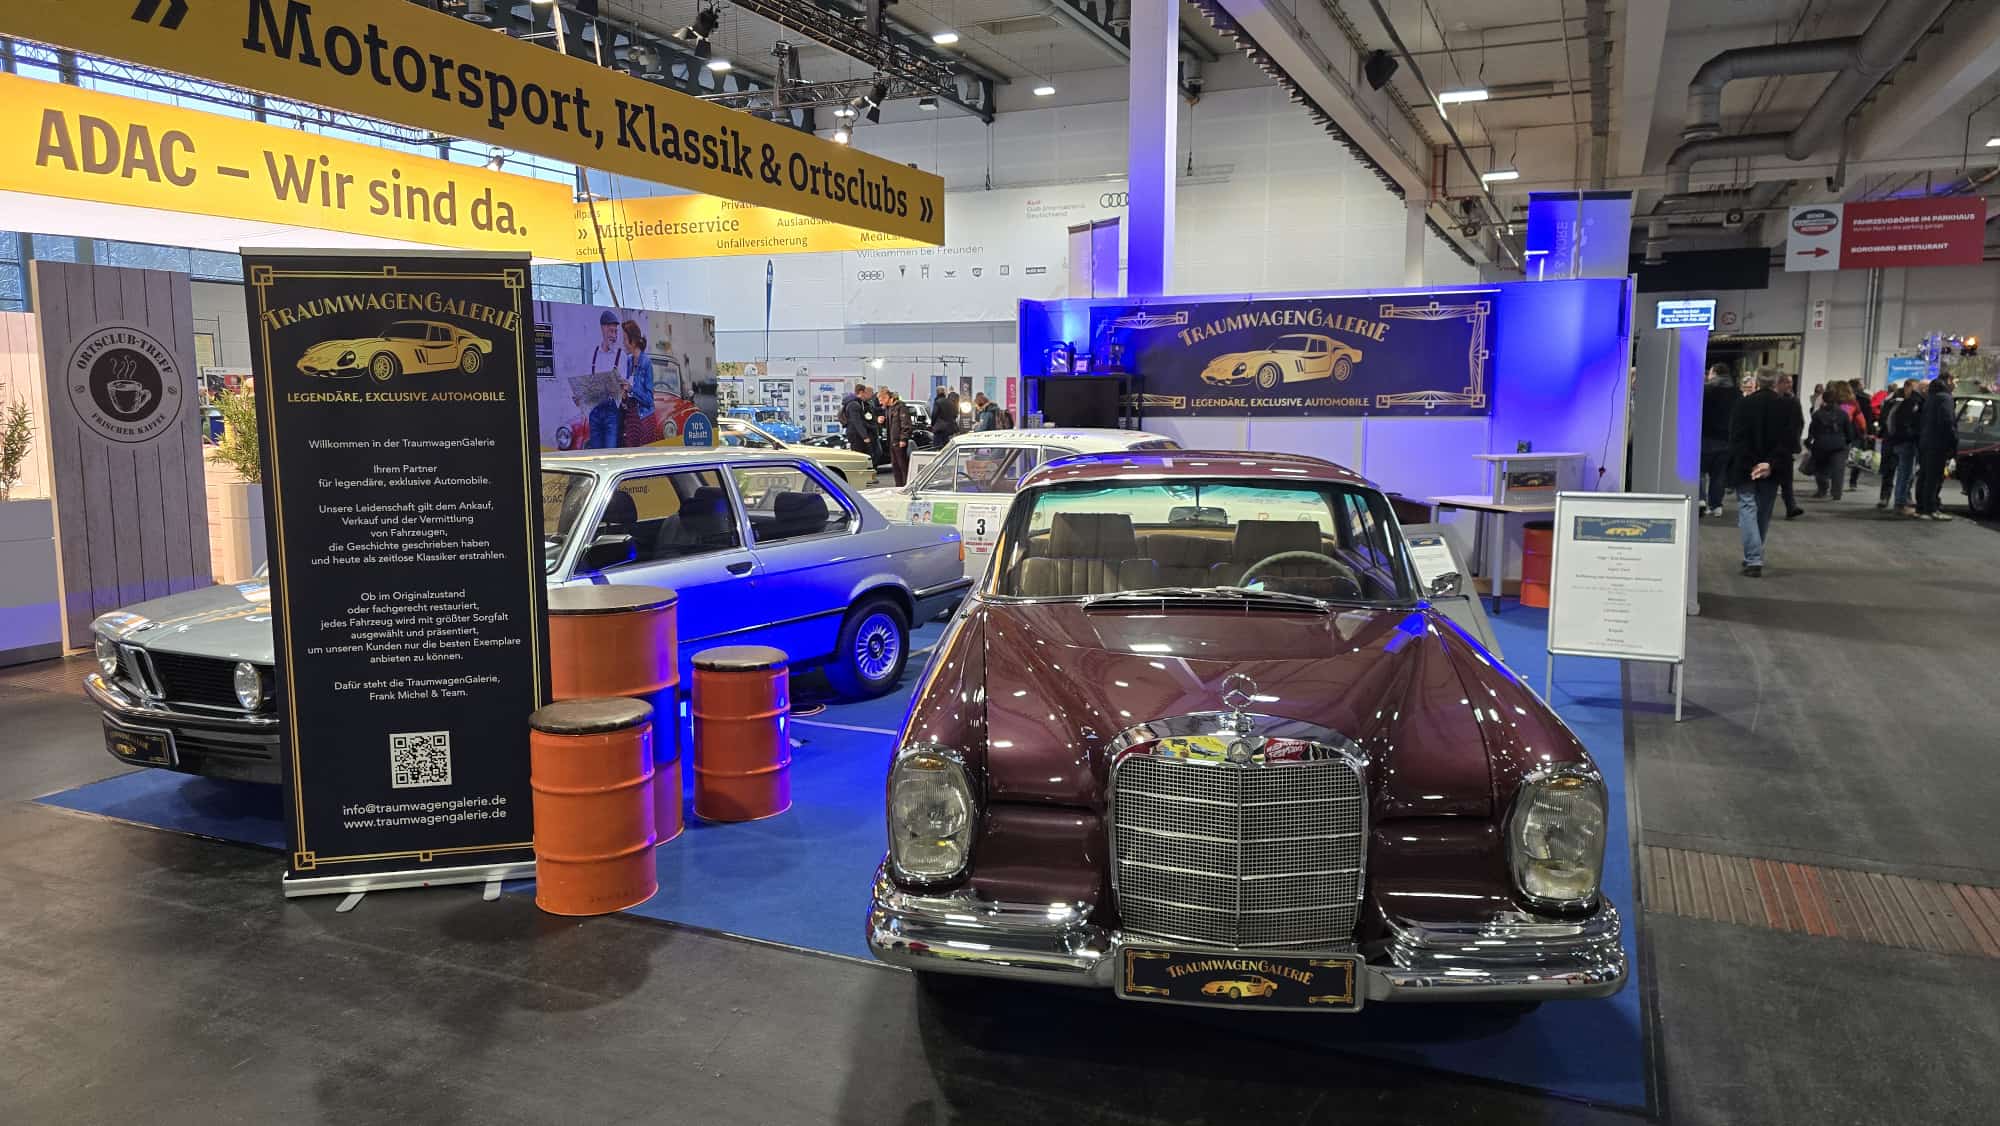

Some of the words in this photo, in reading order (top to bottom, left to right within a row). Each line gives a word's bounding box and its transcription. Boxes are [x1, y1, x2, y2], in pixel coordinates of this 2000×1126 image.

[242, 0, 604, 152] Motorsport,
[617, 100, 754, 181] Klassik
[758, 143, 782, 186] &
[788, 153, 909, 218] Ortsclubs
[36, 108, 197, 187] ADAC
[263, 149, 354, 210] Wir
[369, 168, 457, 227] sind
[470, 188, 529, 237] da.
[1932, 213, 1975, 222] PARKHAUS
[598, 216, 740, 241] Mitgliederservice
[716, 235, 808, 250] Unfallversicherung
[1898, 243, 1949, 252] RESTAURANT
[857, 247, 918, 258] Willkommen
[920, 247, 935, 256] bei
[938, 246, 984, 256] Freunden
[260, 292, 521, 333] TRAUMWAGENGALERIE
[1178, 308, 1391, 347] TRAUMWAGENGALERIE
[77, 333, 173, 374] ORTSCLUB-TREFF
[288, 391, 363, 402] LEGENDÄRE,
[366, 392, 428, 401] EXCLUSIVE
[431, 392, 506, 401] AUTOMOBILE
[1192, 398, 1248, 407] LEGENDÄRE,
[1251, 398, 1303, 407] EXCLUSIVE
[1305, 398, 1369, 407] AUTOMOBILE
[91, 412, 135, 436] FRISCHER
[689, 430, 708, 440] Rabatt
[309, 440, 369, 448] Willkommen
[384, 439, 400, 447] der
[402, 438, 494, 448] TraumwagenGalerie
[374, 465, 400, 473] Ihrem
[319, 479, 332, 487] für
[335, 479, 386, 488] legendäre,
[389, 477, 431, 485] exklusive
[319, 505, 353, 513] Unsere
[356, 503, 415, 512] Leidenschaft
[418, 503, 433, 513] gilt
[459, 501, 493, 509] Ankauf,
[342, 516, 378, 525] Verkauf
[419, 515, 473, 524] Vermittlung
[976, 518, 986, 536] 3
[391, 529, 447, 538] Fahrzeugen,
[329, 543, 344, 551] die
[347, 542, 399, 550] Geschichte
[402, 540, 458, 551] geschrieben
[461, 539, 489, 547] haben
[333, 556, 360, 564] heute
[378, 554, 413, 562] zeitlose
[417, 553, 456, 561] Klassiker
[393, 590, 465, 601] Originalzustand
[347, 606, 370, 614] oder
[372, 603, 427, 614] fachgerecht
[430, 602, 479, 611] restauriert,
[321, 619, 347, 630] jedes
[350, 618, 392, 627] Fahrzeug
[395, 616, 415, 624] wird
[418, 616, 433, 624] mit
[436, 614, 470, 625] größter
[473, 613, 508, 623] Sorgfalt
[351, 629, 403, 640] ausgewählt
[427, 628, 479, 640] präsentiert,
[366, 642, 402, 650] Kunden
[474, 638, 520, 646] Exemplare
[370, 655, 410, 663] anbieten
[335, 681, 360, 690] Dafür
[364, 680, 387, 688] steht
[389, 679, 404, 687] die
[406, 675, 500, 686] TraumwagenGalerie,
[370, 692, 395, 700] Frank
[398, 690, 428, 699] Michel
[343, 795, 506, 818] info@traumwagengalerie.de
[344, 807, 506, 828] www.traumwagengalerie.de
